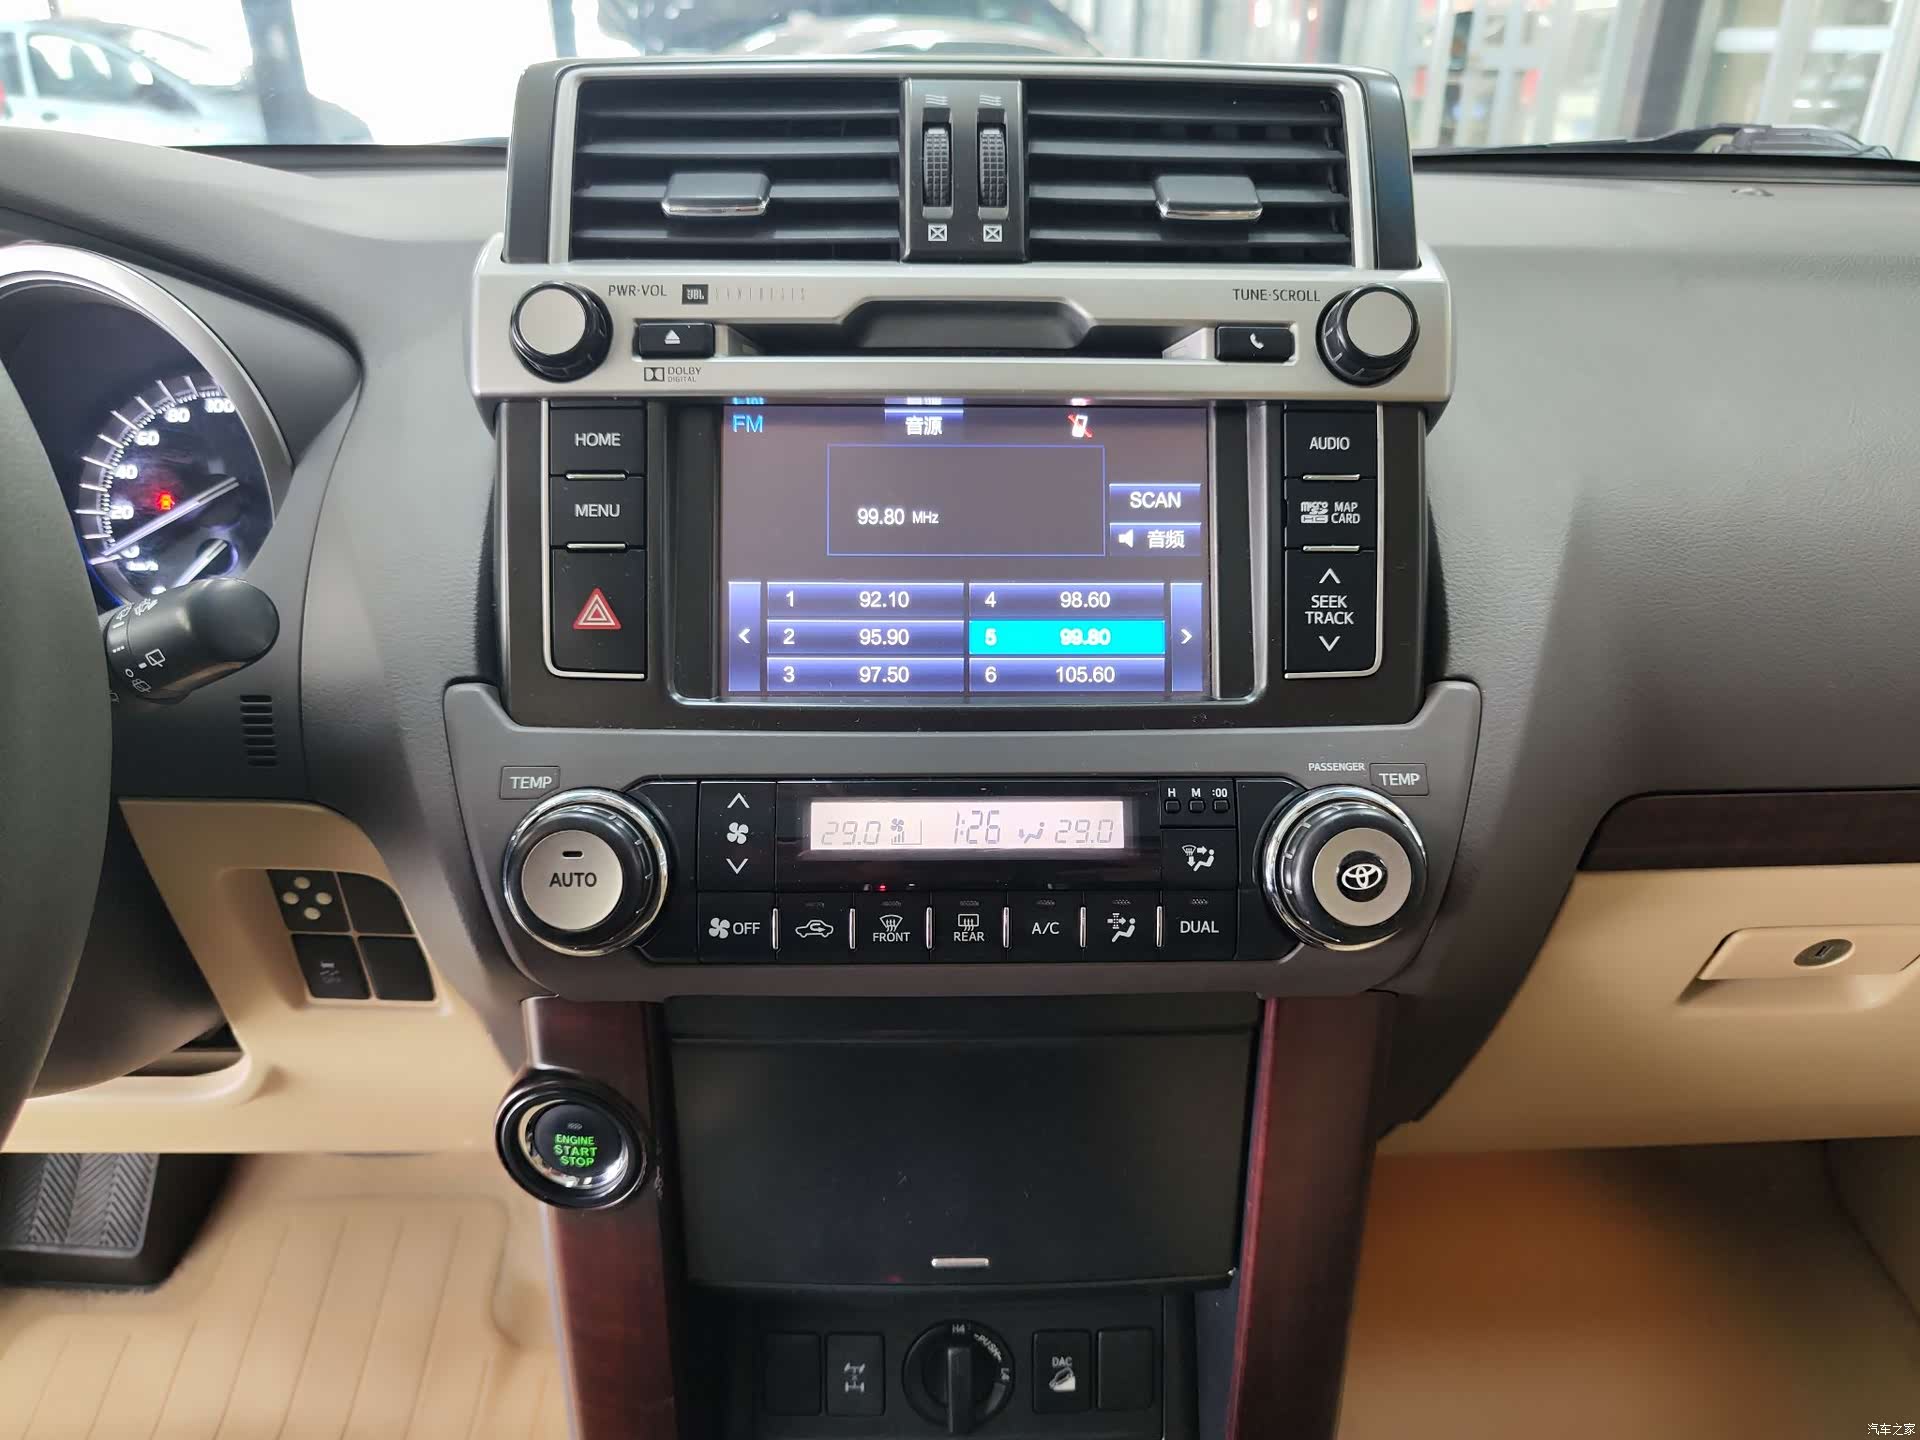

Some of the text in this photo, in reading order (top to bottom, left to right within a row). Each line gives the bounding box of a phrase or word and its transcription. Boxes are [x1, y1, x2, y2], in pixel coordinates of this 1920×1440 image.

[686, 288, 705, 300] JBL
[667, 366, 702, 376] DOLBY
[205, 398, 236, 413] 100
[166, 408, 191, 423] 80
[732, 415, 764, 433] FM
[905, 415, 943, 436] 音源
[136, 431, 160, 446] 60
[574, 432, 622, 447] HOME
[1309, 436, 1350, 451] AUDIO
[1129, 491, 1182, 509] SCAN
[1334, 501, 1358, 513] MAP
[110, 505, 135, 520] 20
[574, 503, 621, 518] MENU
[856, 507, 939, 526] 99.80 MHz
[1331, 513, 1361, 524] CARD
[1146, 529, 1186, 549] 音频
[785, 591, 910, 609] 1 92.10
[984, 591, 1111, 609] 4 98.60
[1311, 595, 1348, 609] SEEK
[1304, 611, 1355, 625] TRACK
[782, 628, 910, 646] 2 95.90
[984, 628, 1112, 647] 5 99.80
[782, 666, 910, 684] 3 97.50
[984, 666, 1116, 684] 6 105.60
[1308, 762, 1365, 772] PASSENGER
[509, 776, 553, 789] TEMP
[1379, 773, 1421, 786] TEMP
[1167, 787, 1229, 798] H M :00
[820, 821, 882, 845] 29.0
[952, 809, 1001, 845] 1:26
[1054, 819, 1114, 844] 29.0
[549, 872, 598, 888] AUTO
[732, 922, 761, 935] OFF
[1031, 922, 1061, 936] A/C
[1180, 920, 1220, 934] DUAL
[872, 931, 912, 943] FRONT
[953, 931, 985, 943] REAR
[554, 1133, 595, 1145] ENGINE
[553, 1144, 598, 1157] START
[559, 1155, 595, 1167] STOP
[951, 1323, 966, 1335] H4
[1051, 1356, 1074, 1367] DAC
